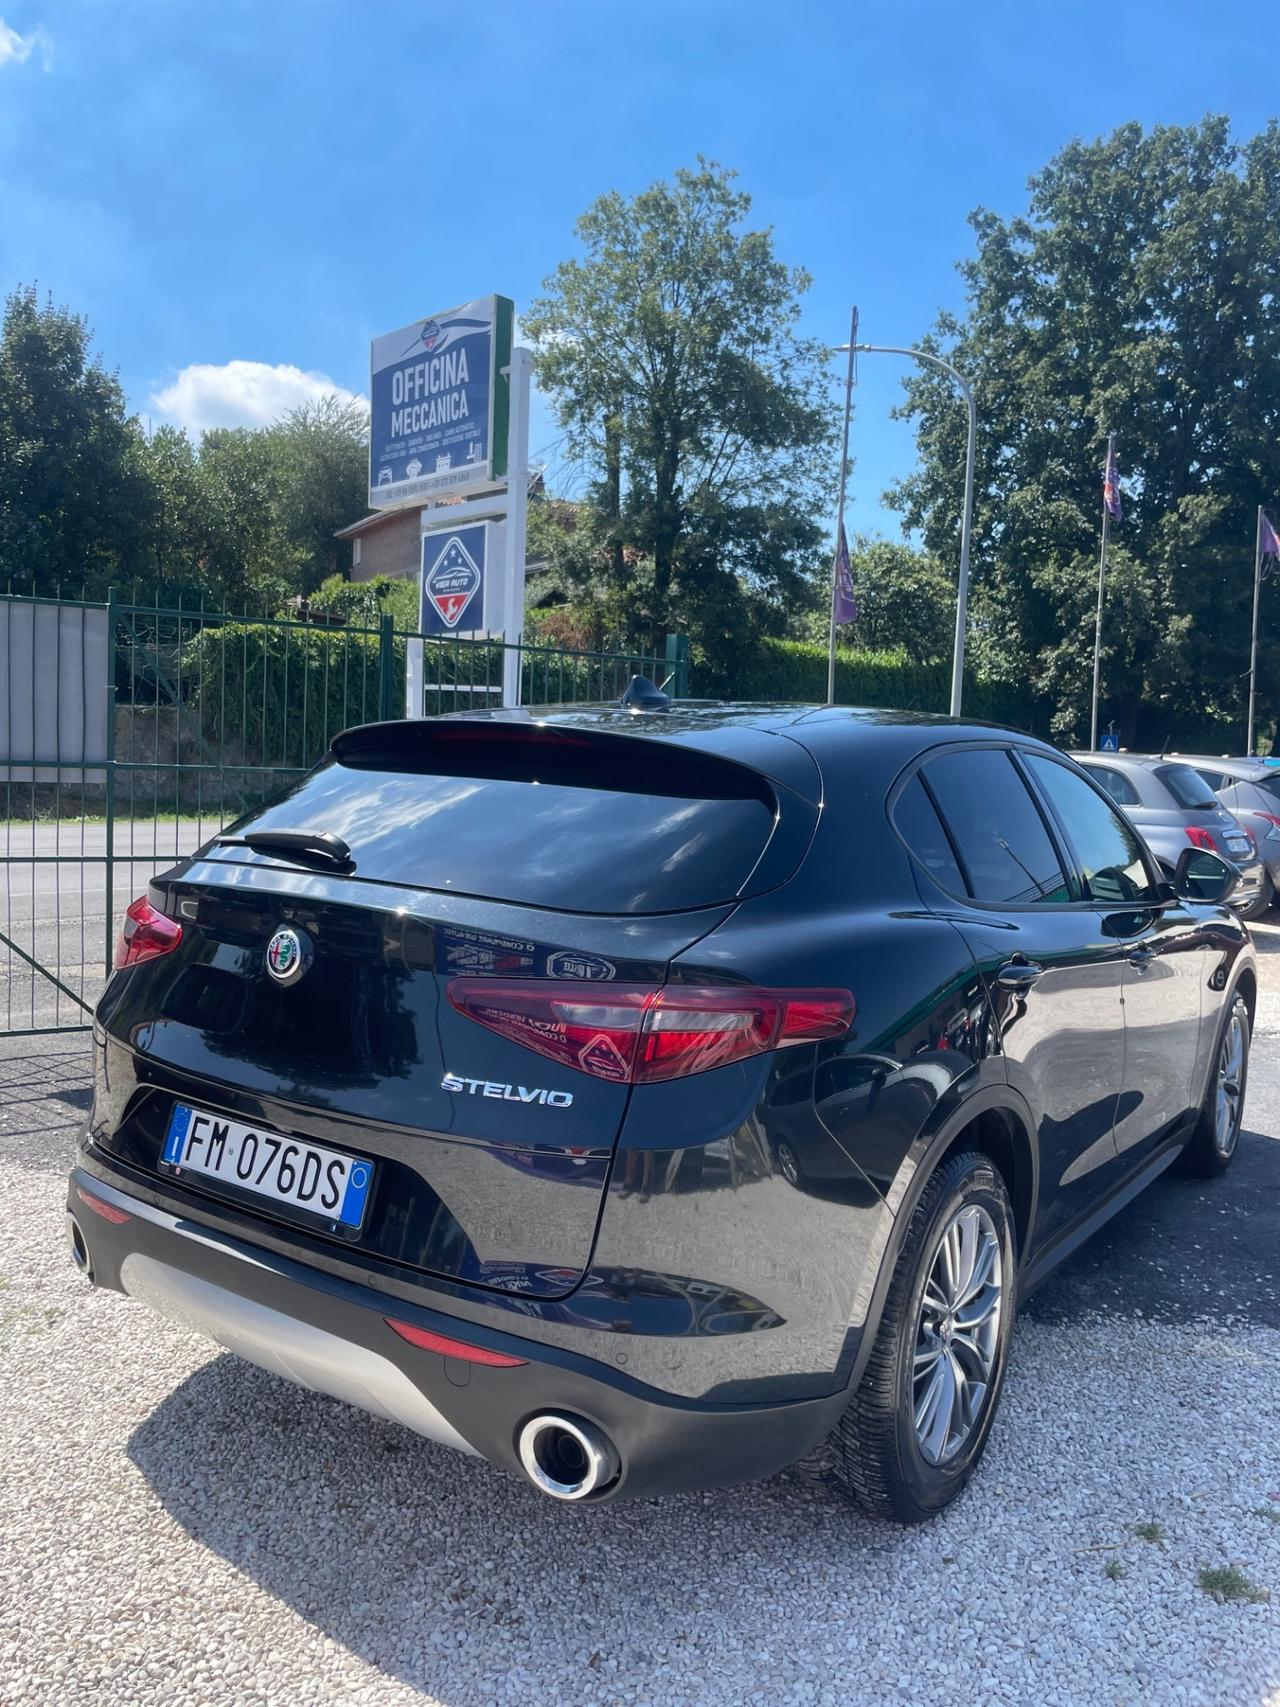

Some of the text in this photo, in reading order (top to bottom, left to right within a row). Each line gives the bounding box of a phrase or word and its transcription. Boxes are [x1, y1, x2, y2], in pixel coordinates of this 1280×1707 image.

[392, 348, 469, 406] OFFICINA
[391, 390, 469, 438] MECCANICA
[450, 578, 468, 587] AUTO
[441, 1074, 574, 1108] STELVIO
[185, 1117, 345, 1210] FM 076DS
